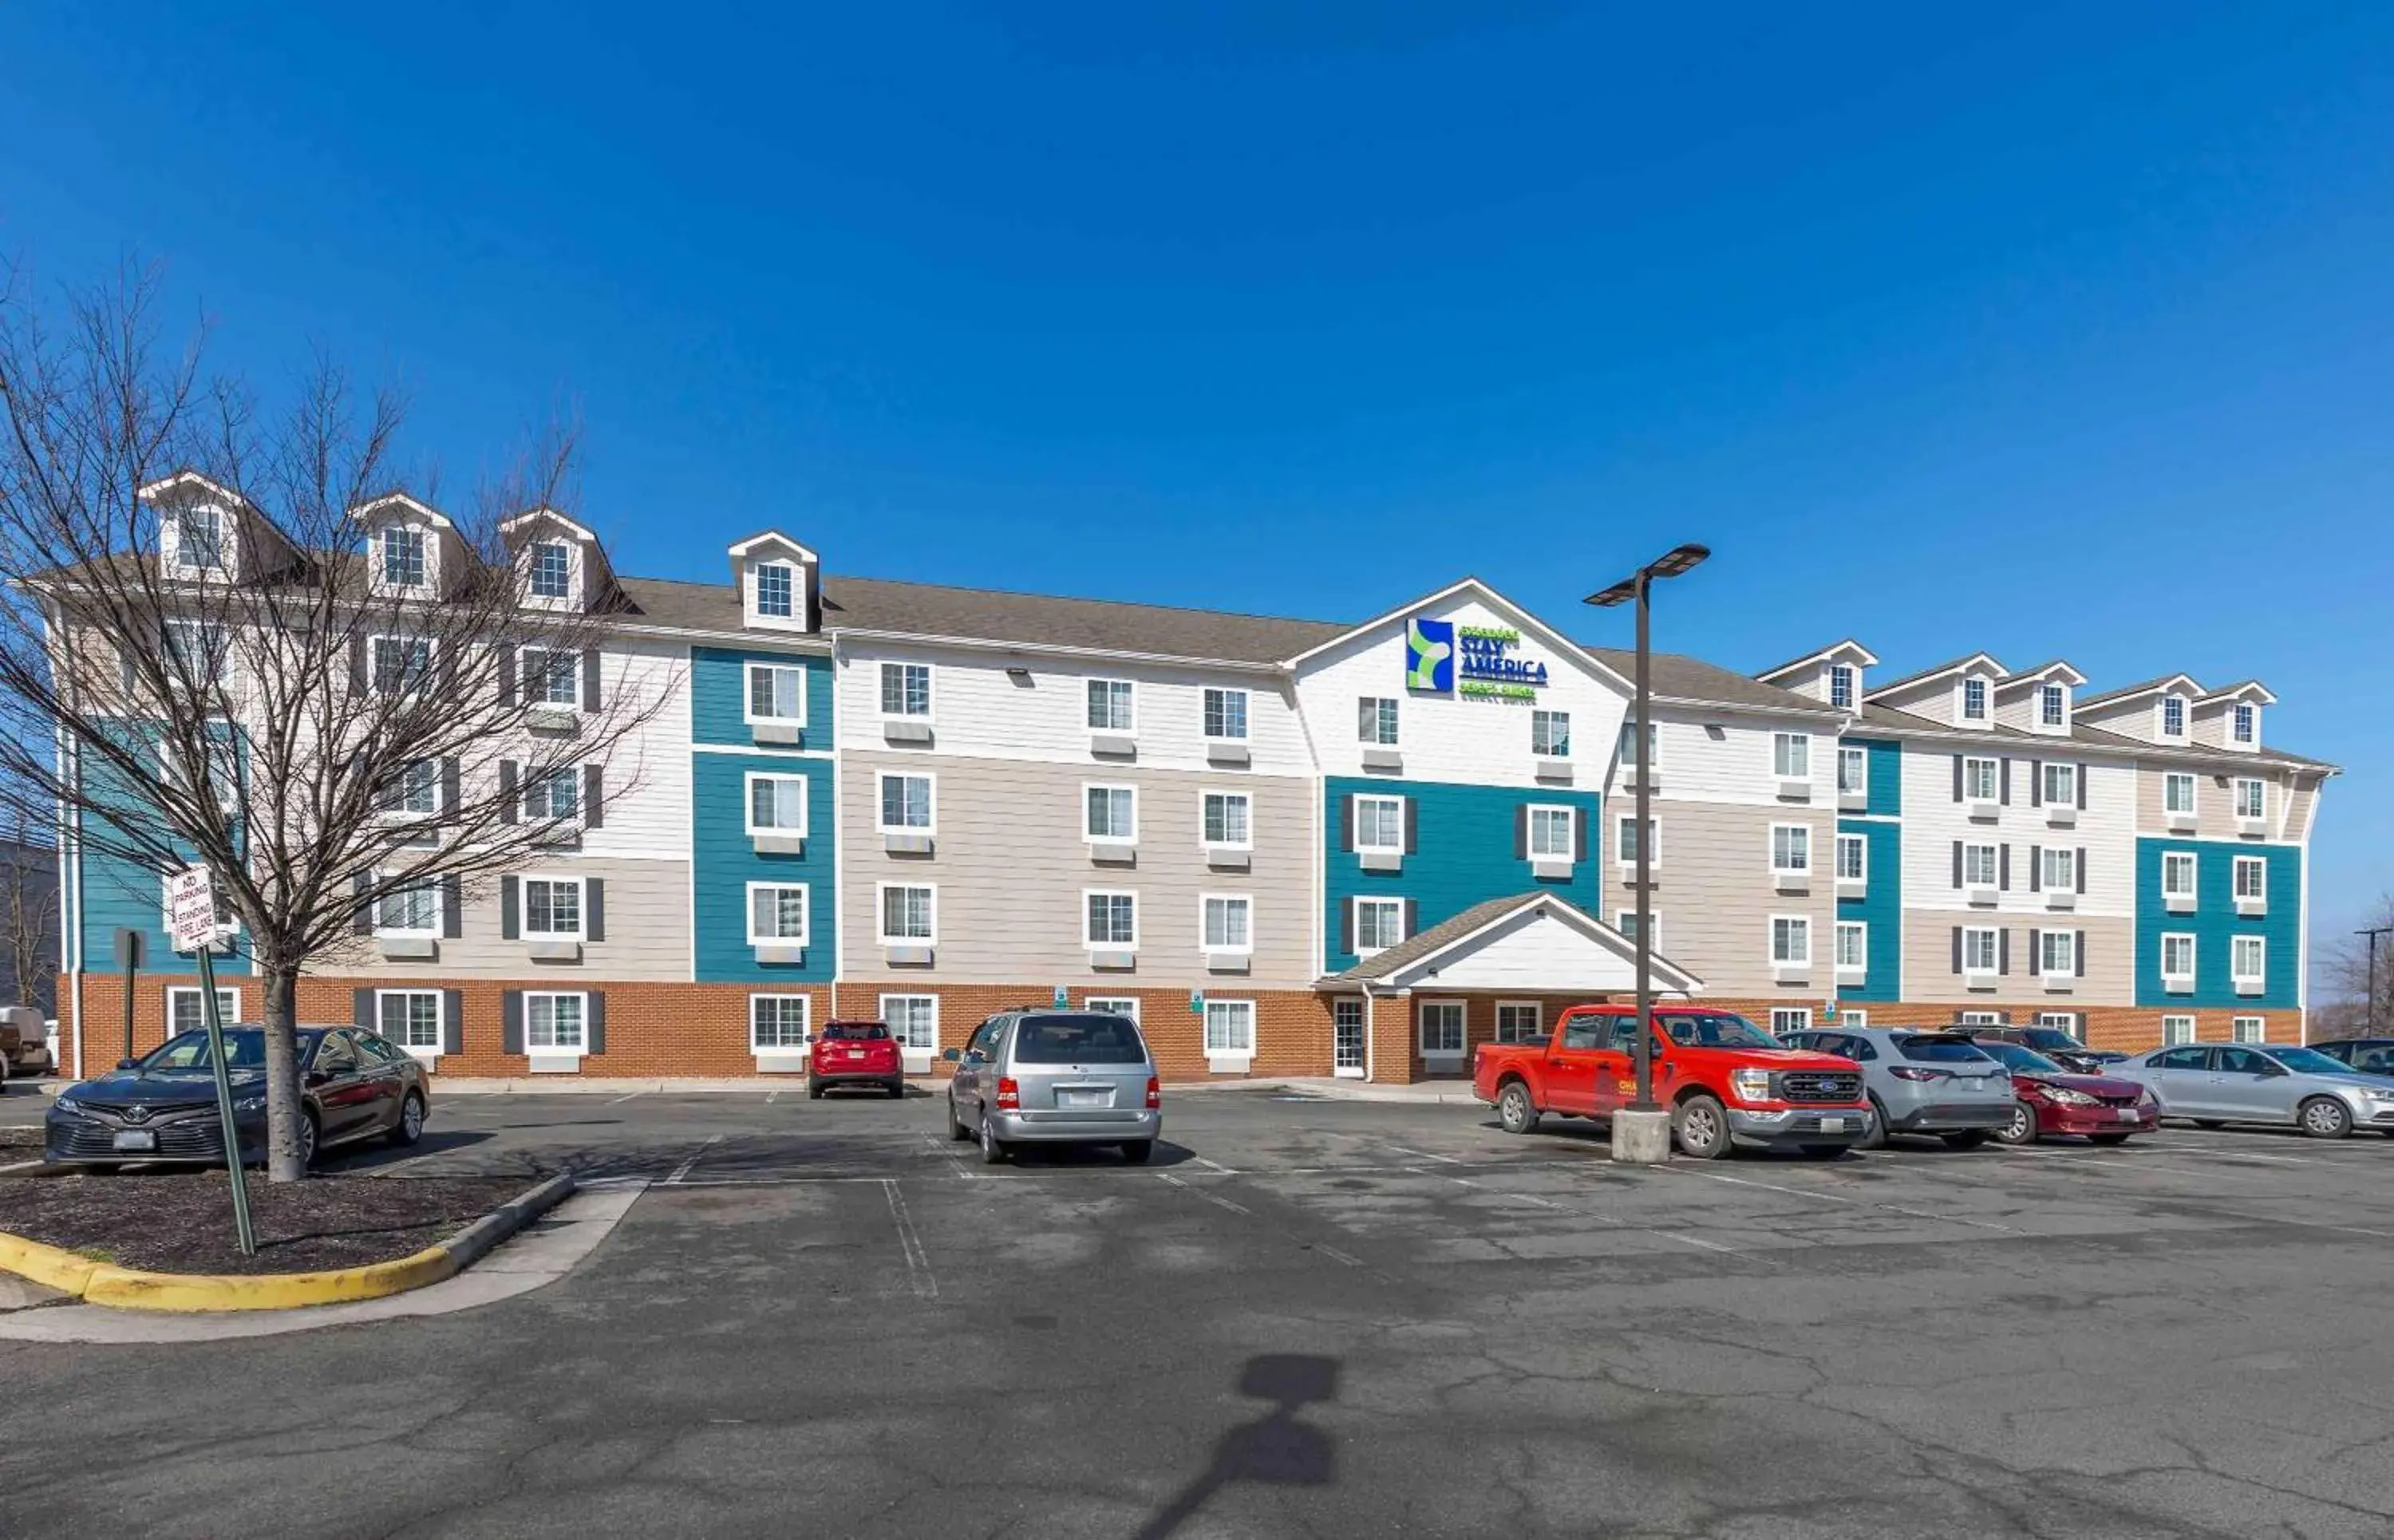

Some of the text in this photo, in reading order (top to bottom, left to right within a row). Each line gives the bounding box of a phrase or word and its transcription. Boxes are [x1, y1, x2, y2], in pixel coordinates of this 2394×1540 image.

[1460, 636, 1504, 655] STAY
[1462, 655, 1547, 678] AMERICA
[183, 876, 196, 888] NO
[176, 883, 207, 902] PARKING
[178, 903, 211, 923] STANDING
